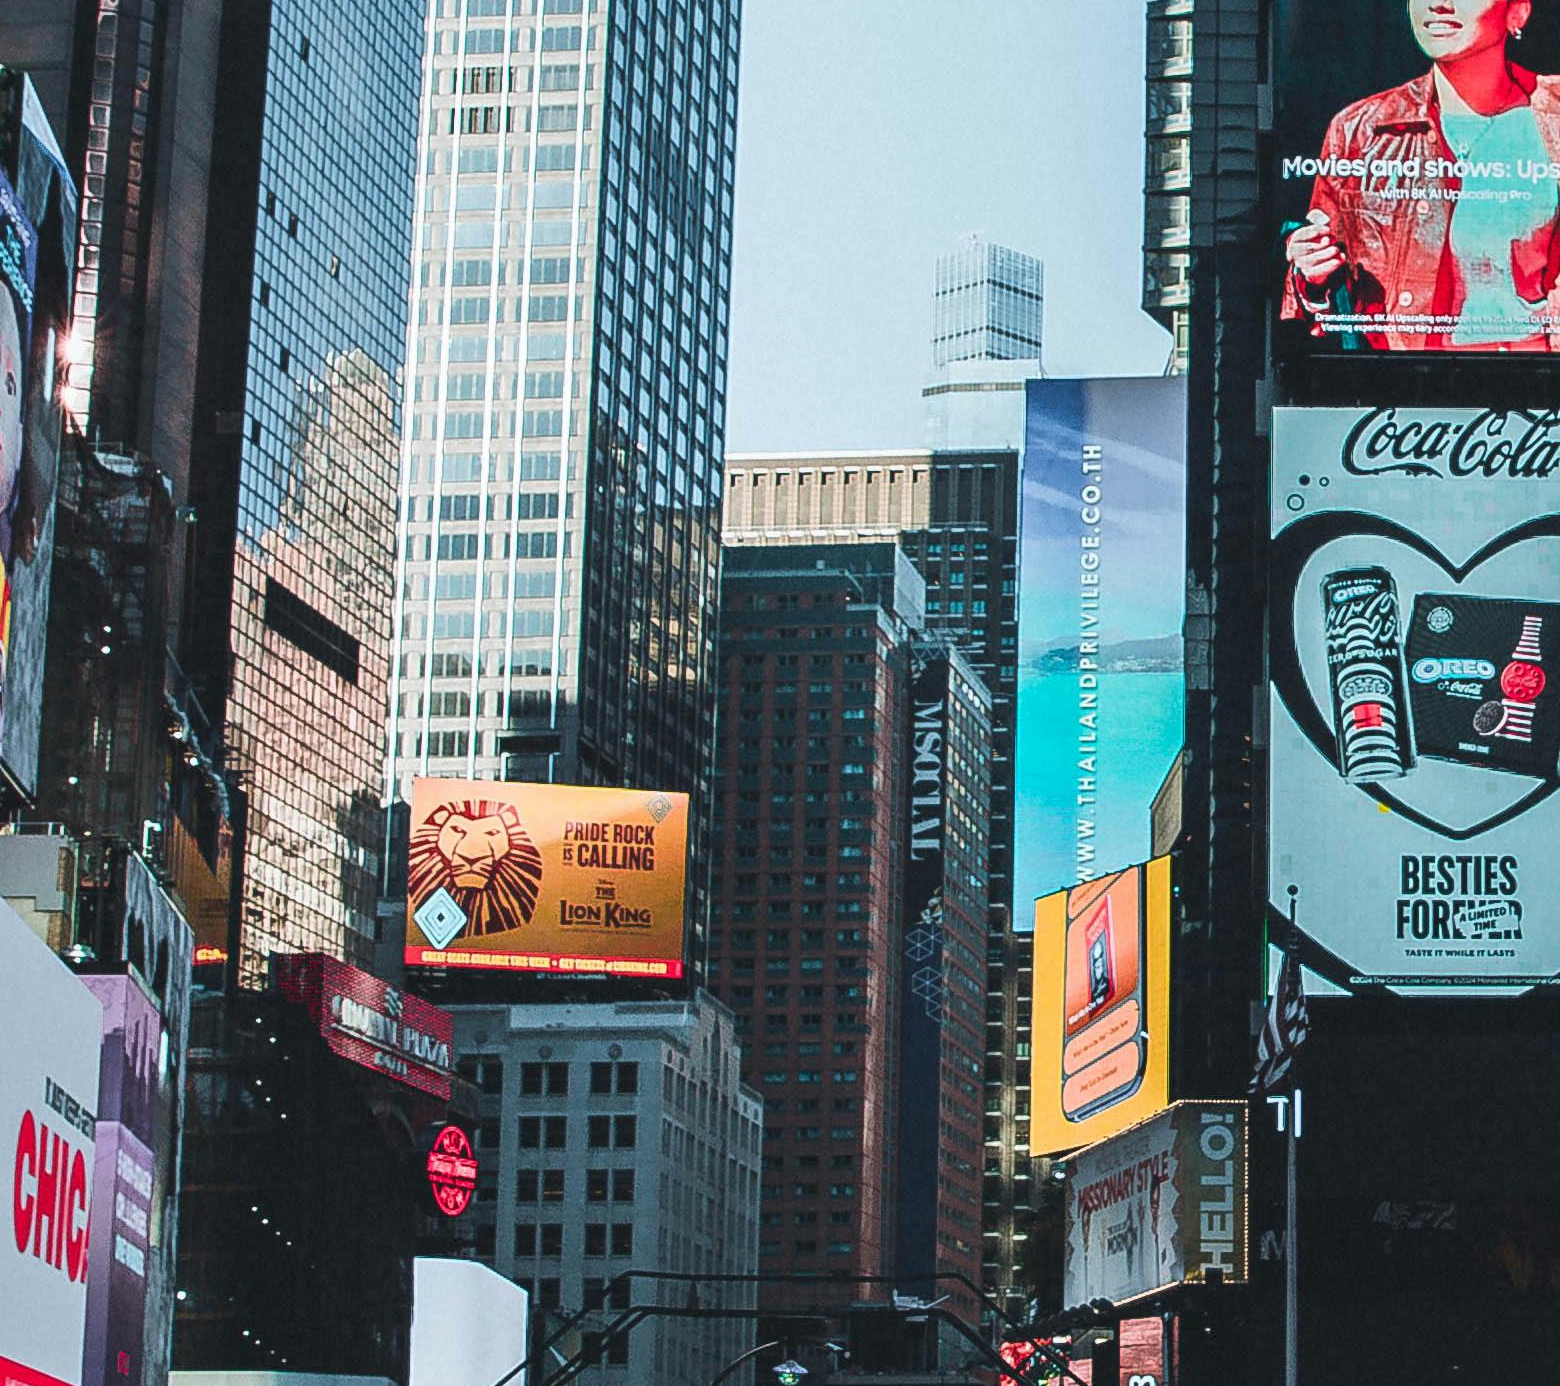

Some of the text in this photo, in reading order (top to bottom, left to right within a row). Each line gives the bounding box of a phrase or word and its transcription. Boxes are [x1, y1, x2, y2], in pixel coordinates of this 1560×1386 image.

[1283, 156, 1365, 179] Movies
[1370, 157, 1420, 178] and
[1425, 158, 1511, 179] shows:
[1413, 658, 1495, 683] OREO
[564, 821, 654, 845] PRIDE ROCK
[577, 843, 654, 871] CALLING
[1401, 855, 1518, 895] BESTIES
[561, 900, 651, 927] LION KING
[1473, 920, 1497, 931] TIME
[1405, 949, 1515, 957] TASTE IT WHILE IT LASTS
[1200, 1112, 1235, 1273] HELLO!
